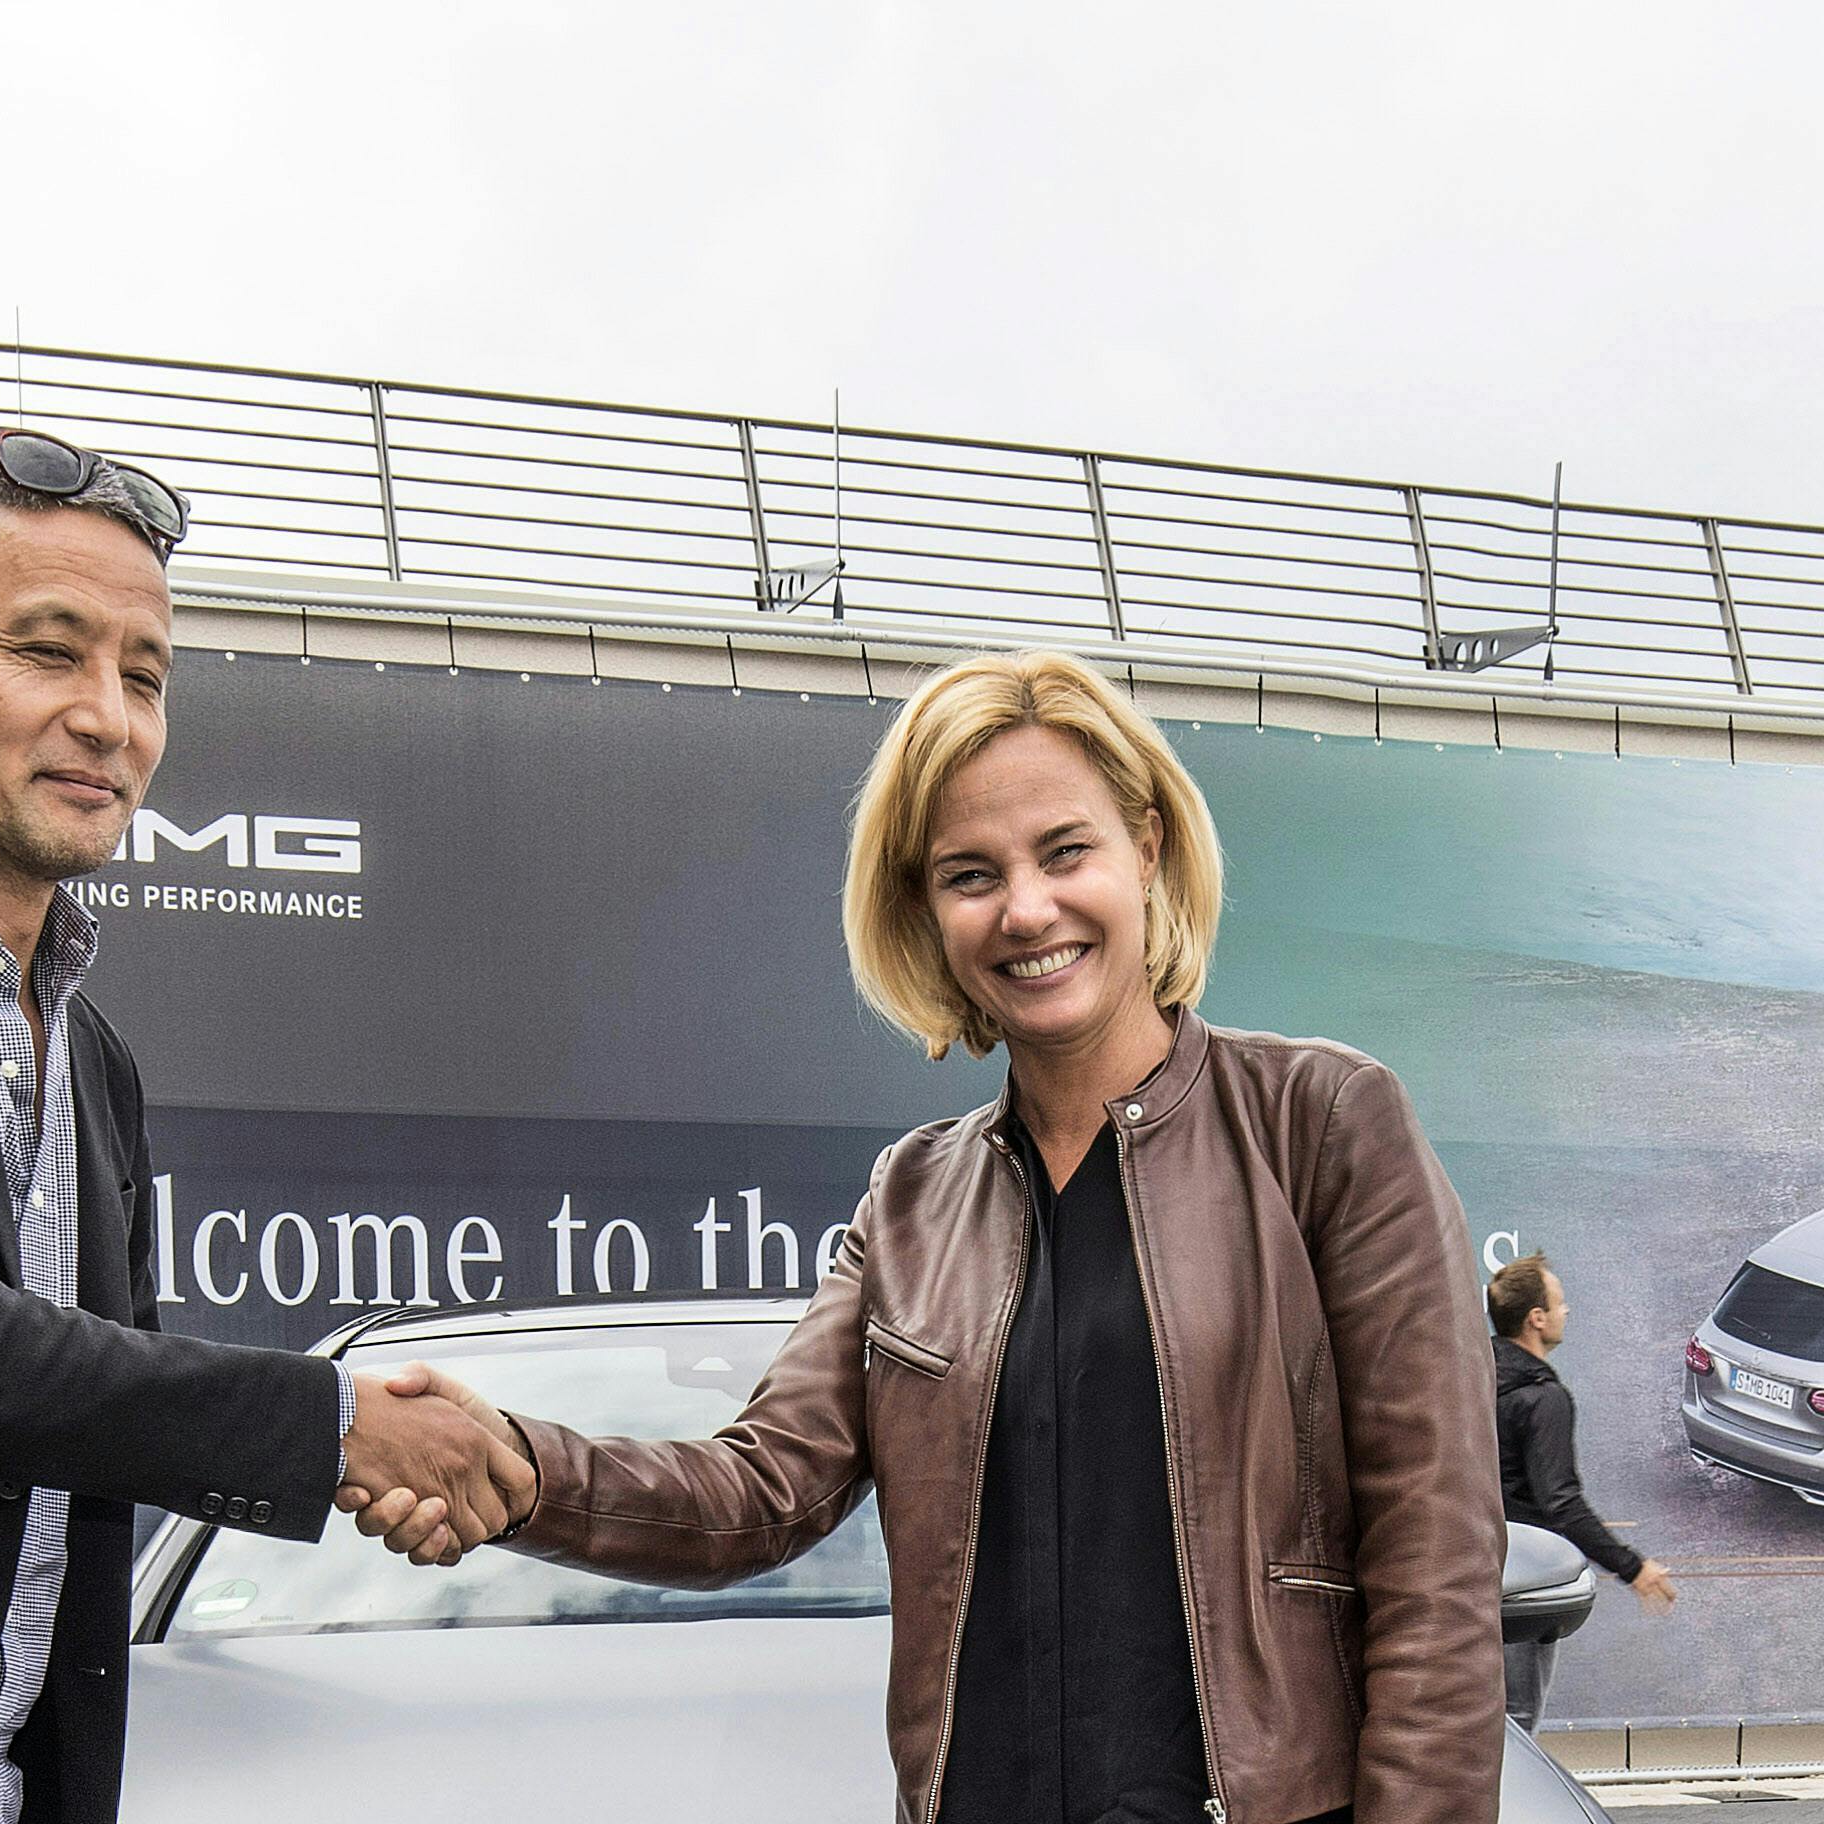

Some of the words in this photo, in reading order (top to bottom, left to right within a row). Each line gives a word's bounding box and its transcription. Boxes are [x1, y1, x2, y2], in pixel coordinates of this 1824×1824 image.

[112, 808, 362, 874] MG
[143, 885, 364, 920] PERFORMANCE
[152, 1173, 503, 1307] lcome
[547, 1193, 651, 1296] to
